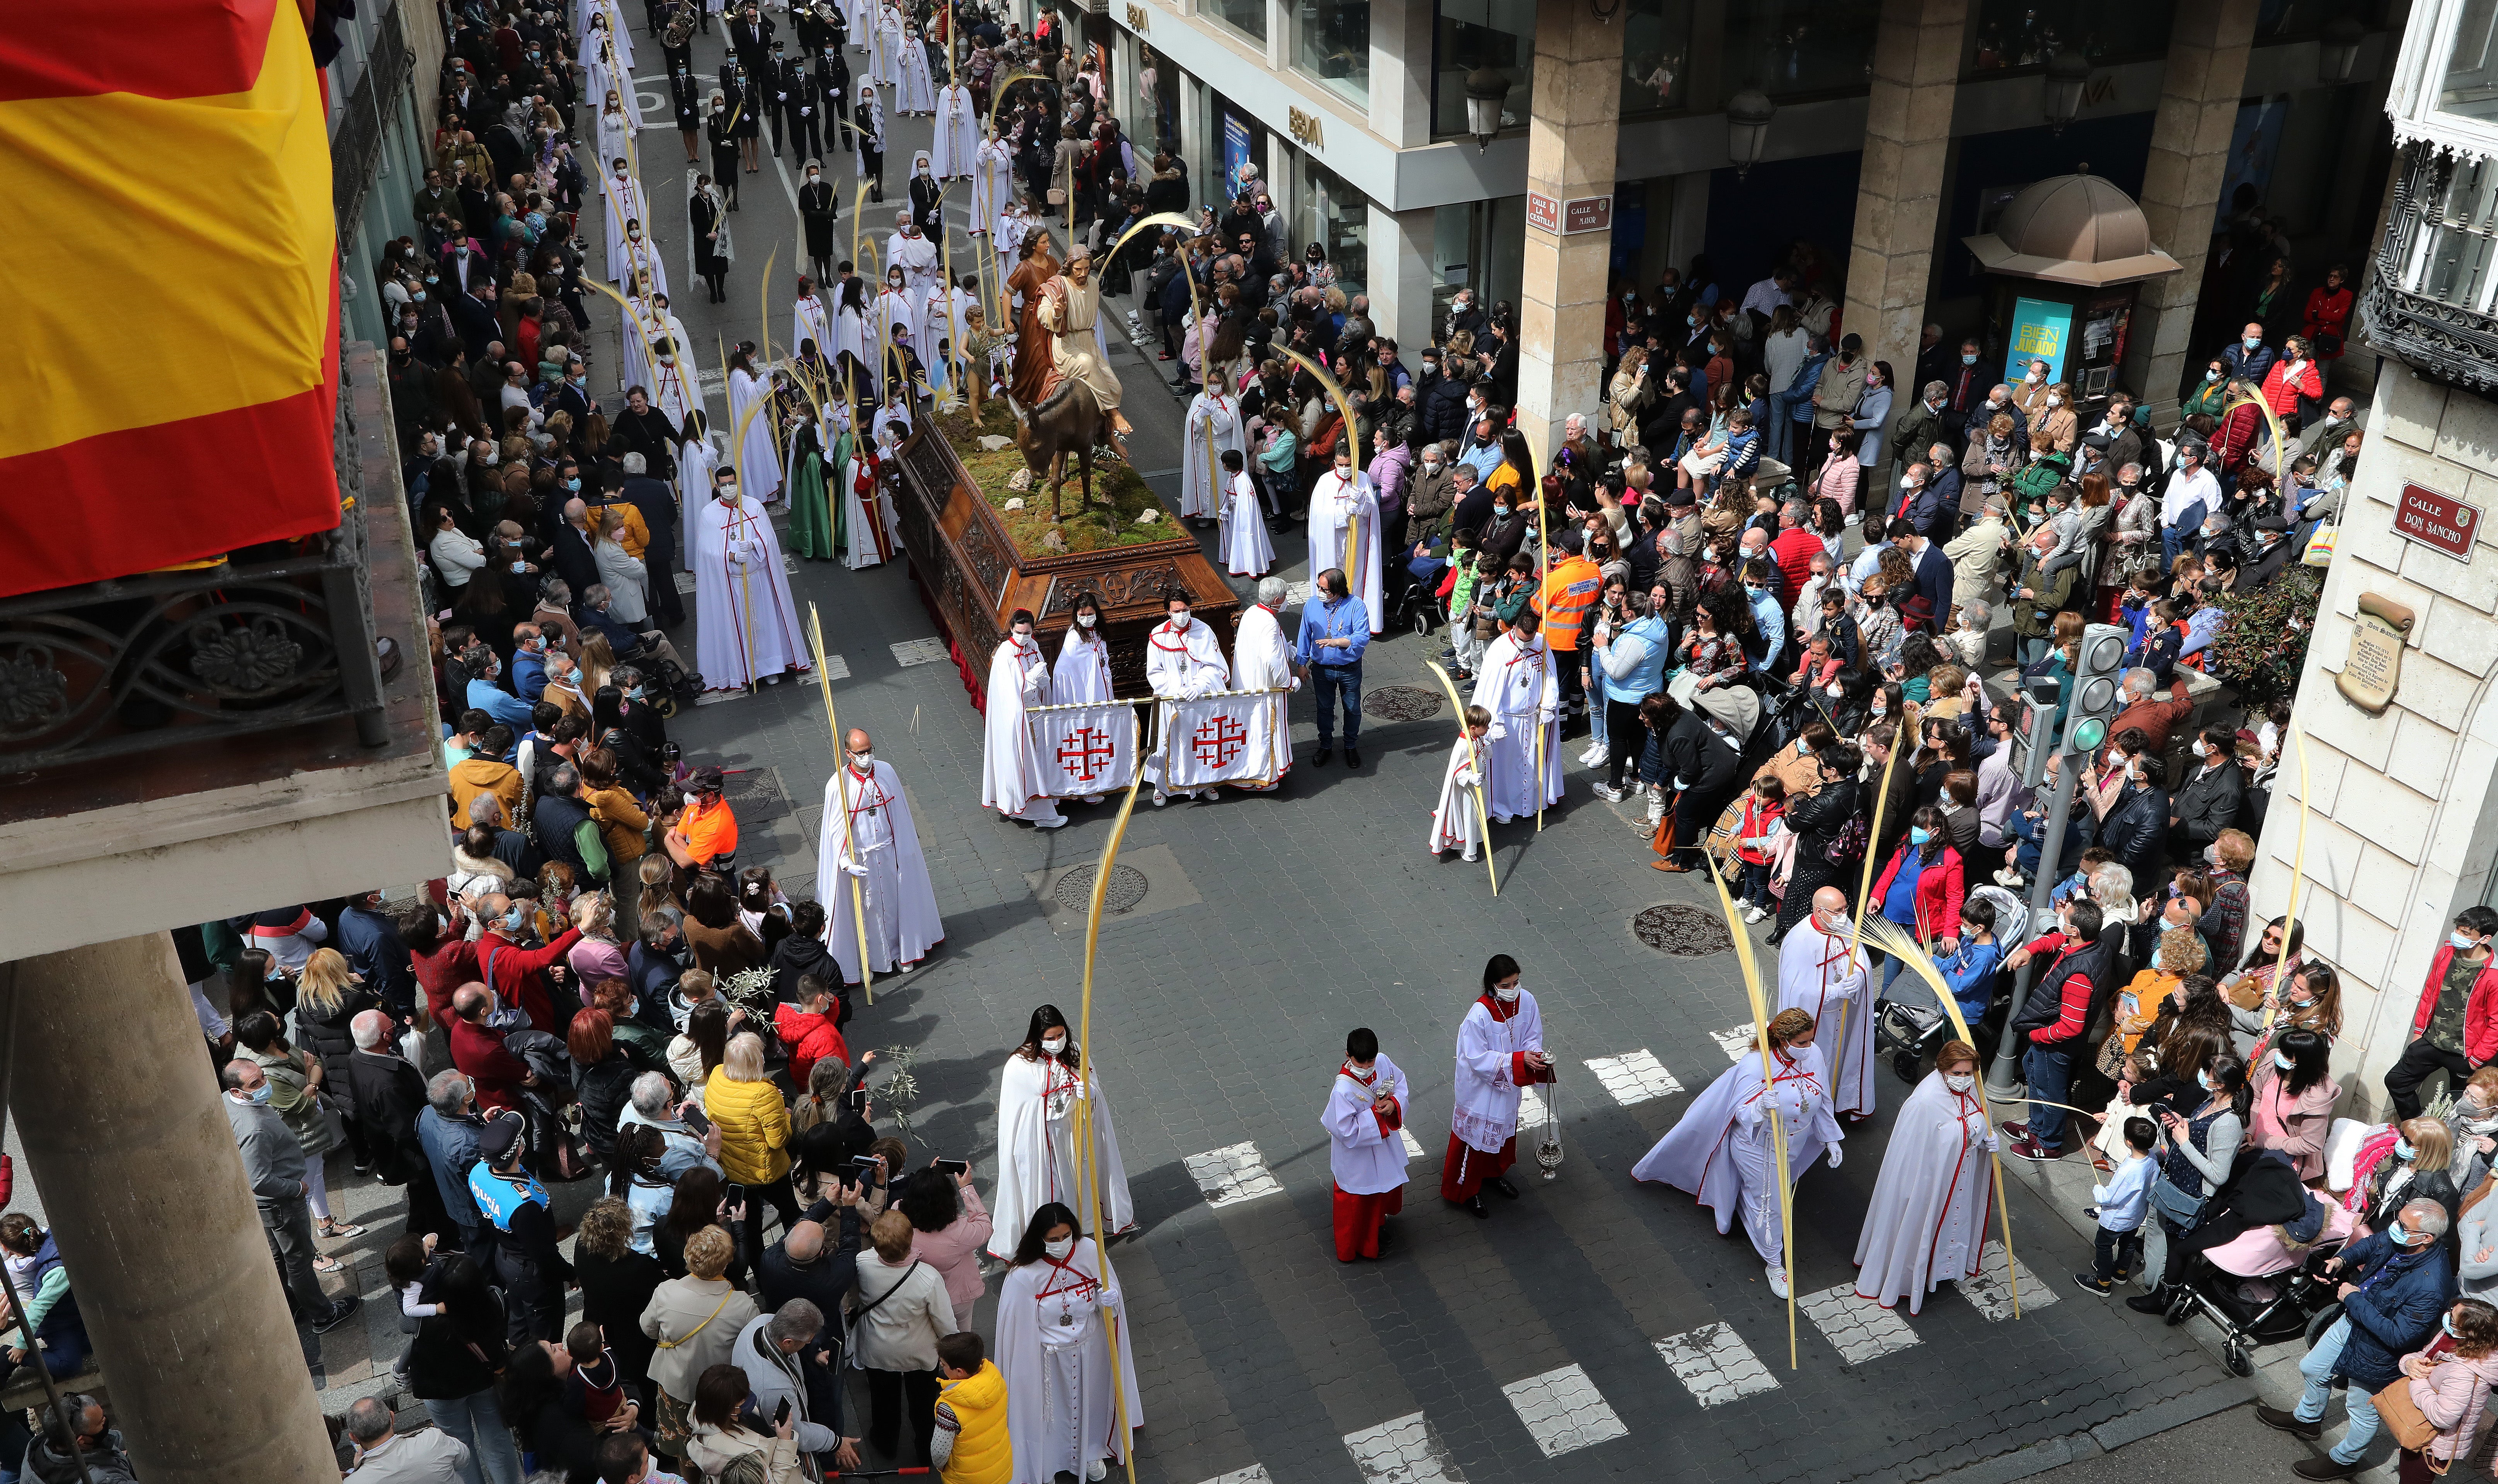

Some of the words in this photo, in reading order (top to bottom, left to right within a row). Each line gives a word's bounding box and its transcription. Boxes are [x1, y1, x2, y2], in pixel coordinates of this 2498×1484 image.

[1127, 2, 1148, 31] BBVA
[1289, 105, 1323, 146] BBVA
[1532, 197, 1546, 209] CALLE
[1536, 207, 1543, 215] LA
[1571, 206, 1591, 214] CALLE
[1530, 213, 1555, 228] CESTILLA
[1579, 216, 1596, 225] MAYOR
[2021, 325, 2060, 342] BIEN
[2014, 337, 2057, 357] JUGADO
[2409, 497, 2442, 517] CALLE
[2404, 512, 2424, 528] DON
[2426, 521, 2461, 544] SANCHO
[2367, 620, 2379, 631] Don
[2379, 628, 2401, 641] Sancho
[2363, 639, 2375, 647] Siglos
[2375, 645, 2389, 655] XV-XVI
[2368, 647, 2384, 657] Principal
[2362, 678, 2374, 687] Palacio
[2372, 673, 2384, 682] Iglesia
[472, 1180, 501, 1218] POLICÍA
